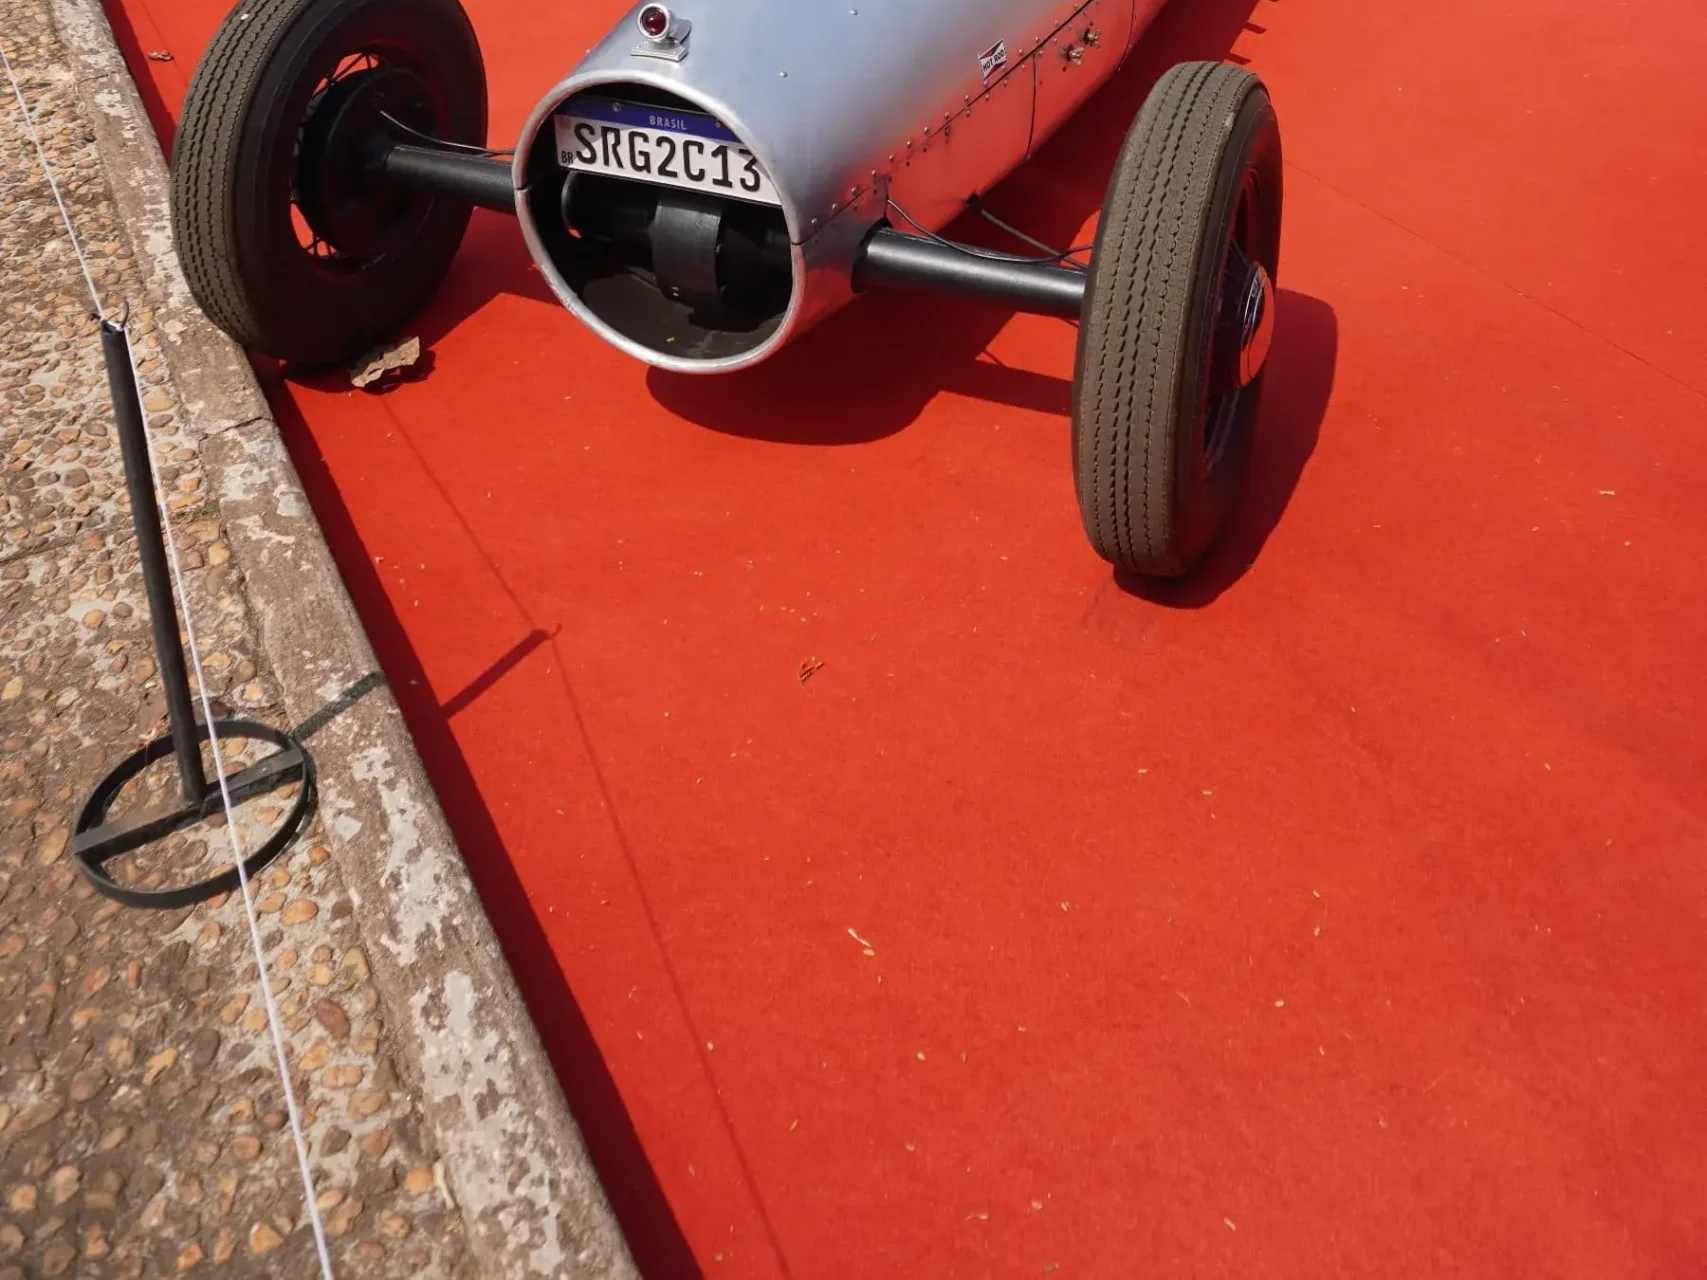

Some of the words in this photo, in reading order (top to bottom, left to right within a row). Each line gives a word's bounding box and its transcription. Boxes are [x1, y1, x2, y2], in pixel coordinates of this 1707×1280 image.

[982, 58, 993, 71] HOT
[649, 115, 688, 131] BRASIL
[561, 150, 574, 165] BR
[574, 122, 761, 193] SRG2C13
